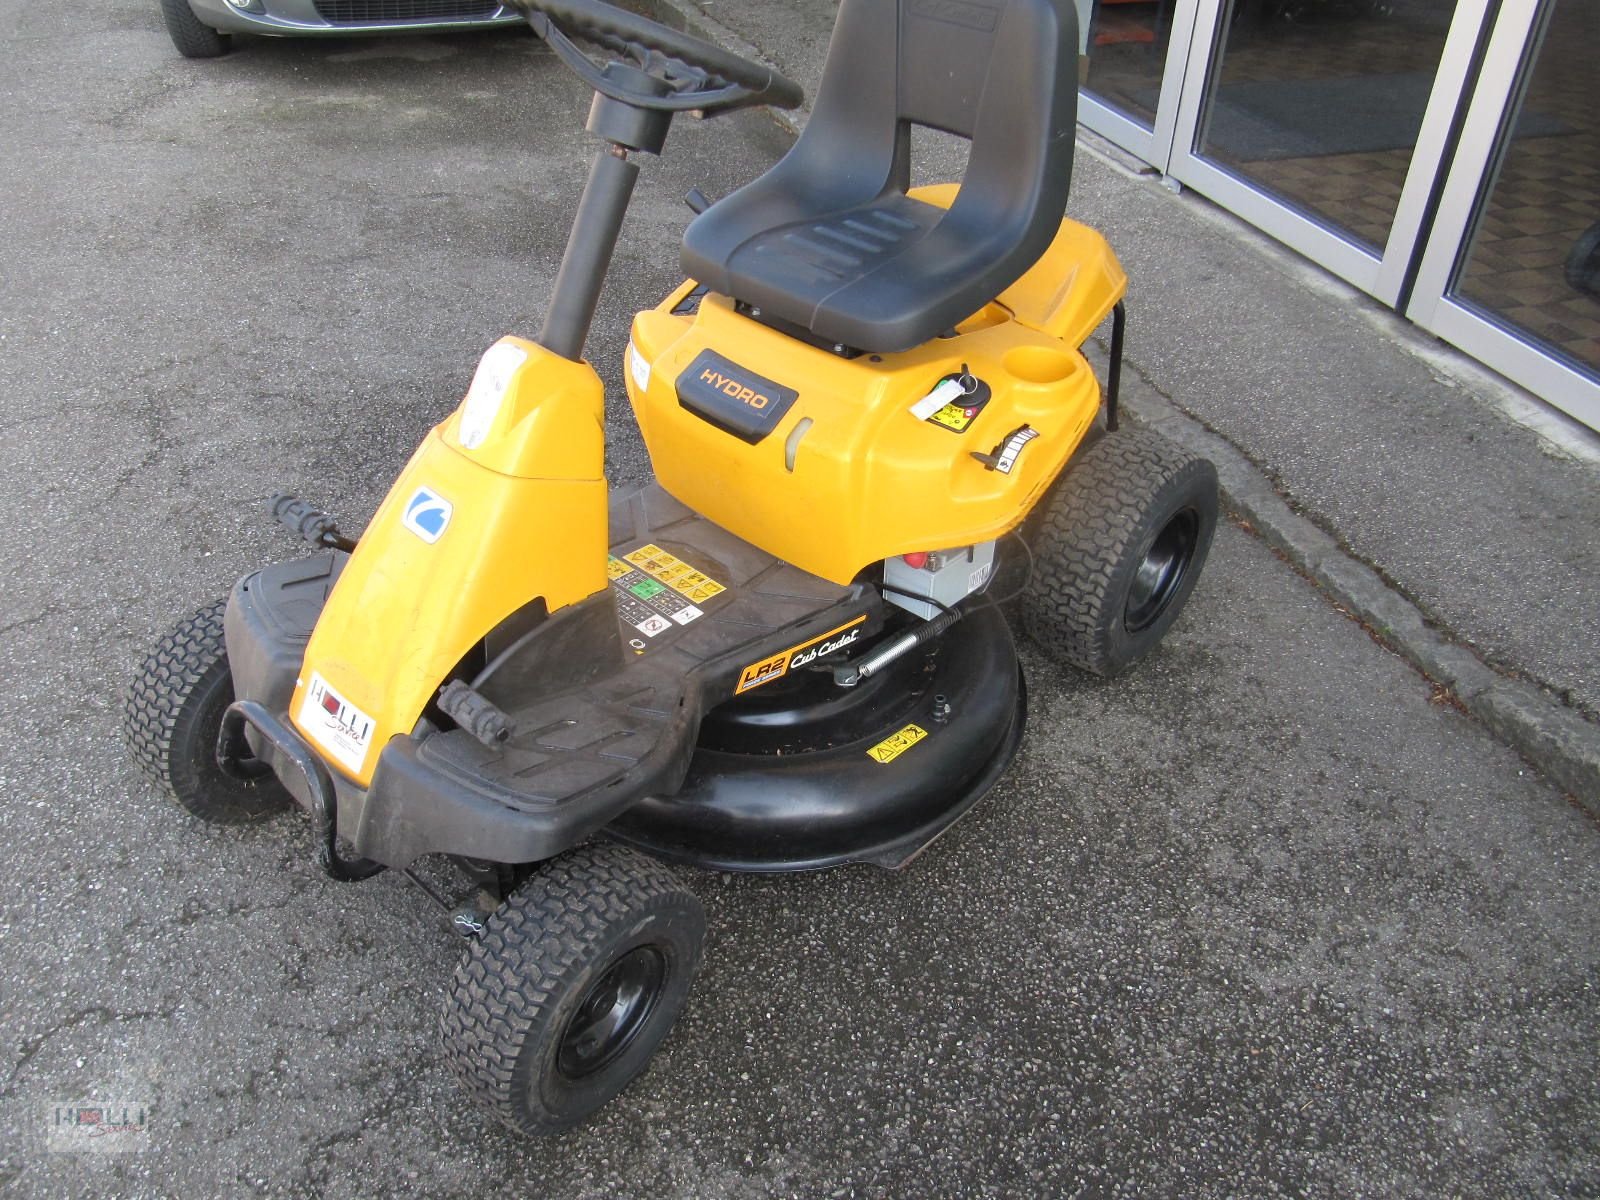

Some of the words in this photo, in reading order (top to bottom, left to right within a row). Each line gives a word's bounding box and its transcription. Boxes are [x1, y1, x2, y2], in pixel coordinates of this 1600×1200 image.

[700, 368, 769, 409] HYDRO
[790, 649, 817, 669] Cub
[818, 629, 859, 657] Cadet
[743, 656, 786, 683] LR2
[324, 715, 363, 746] Service
